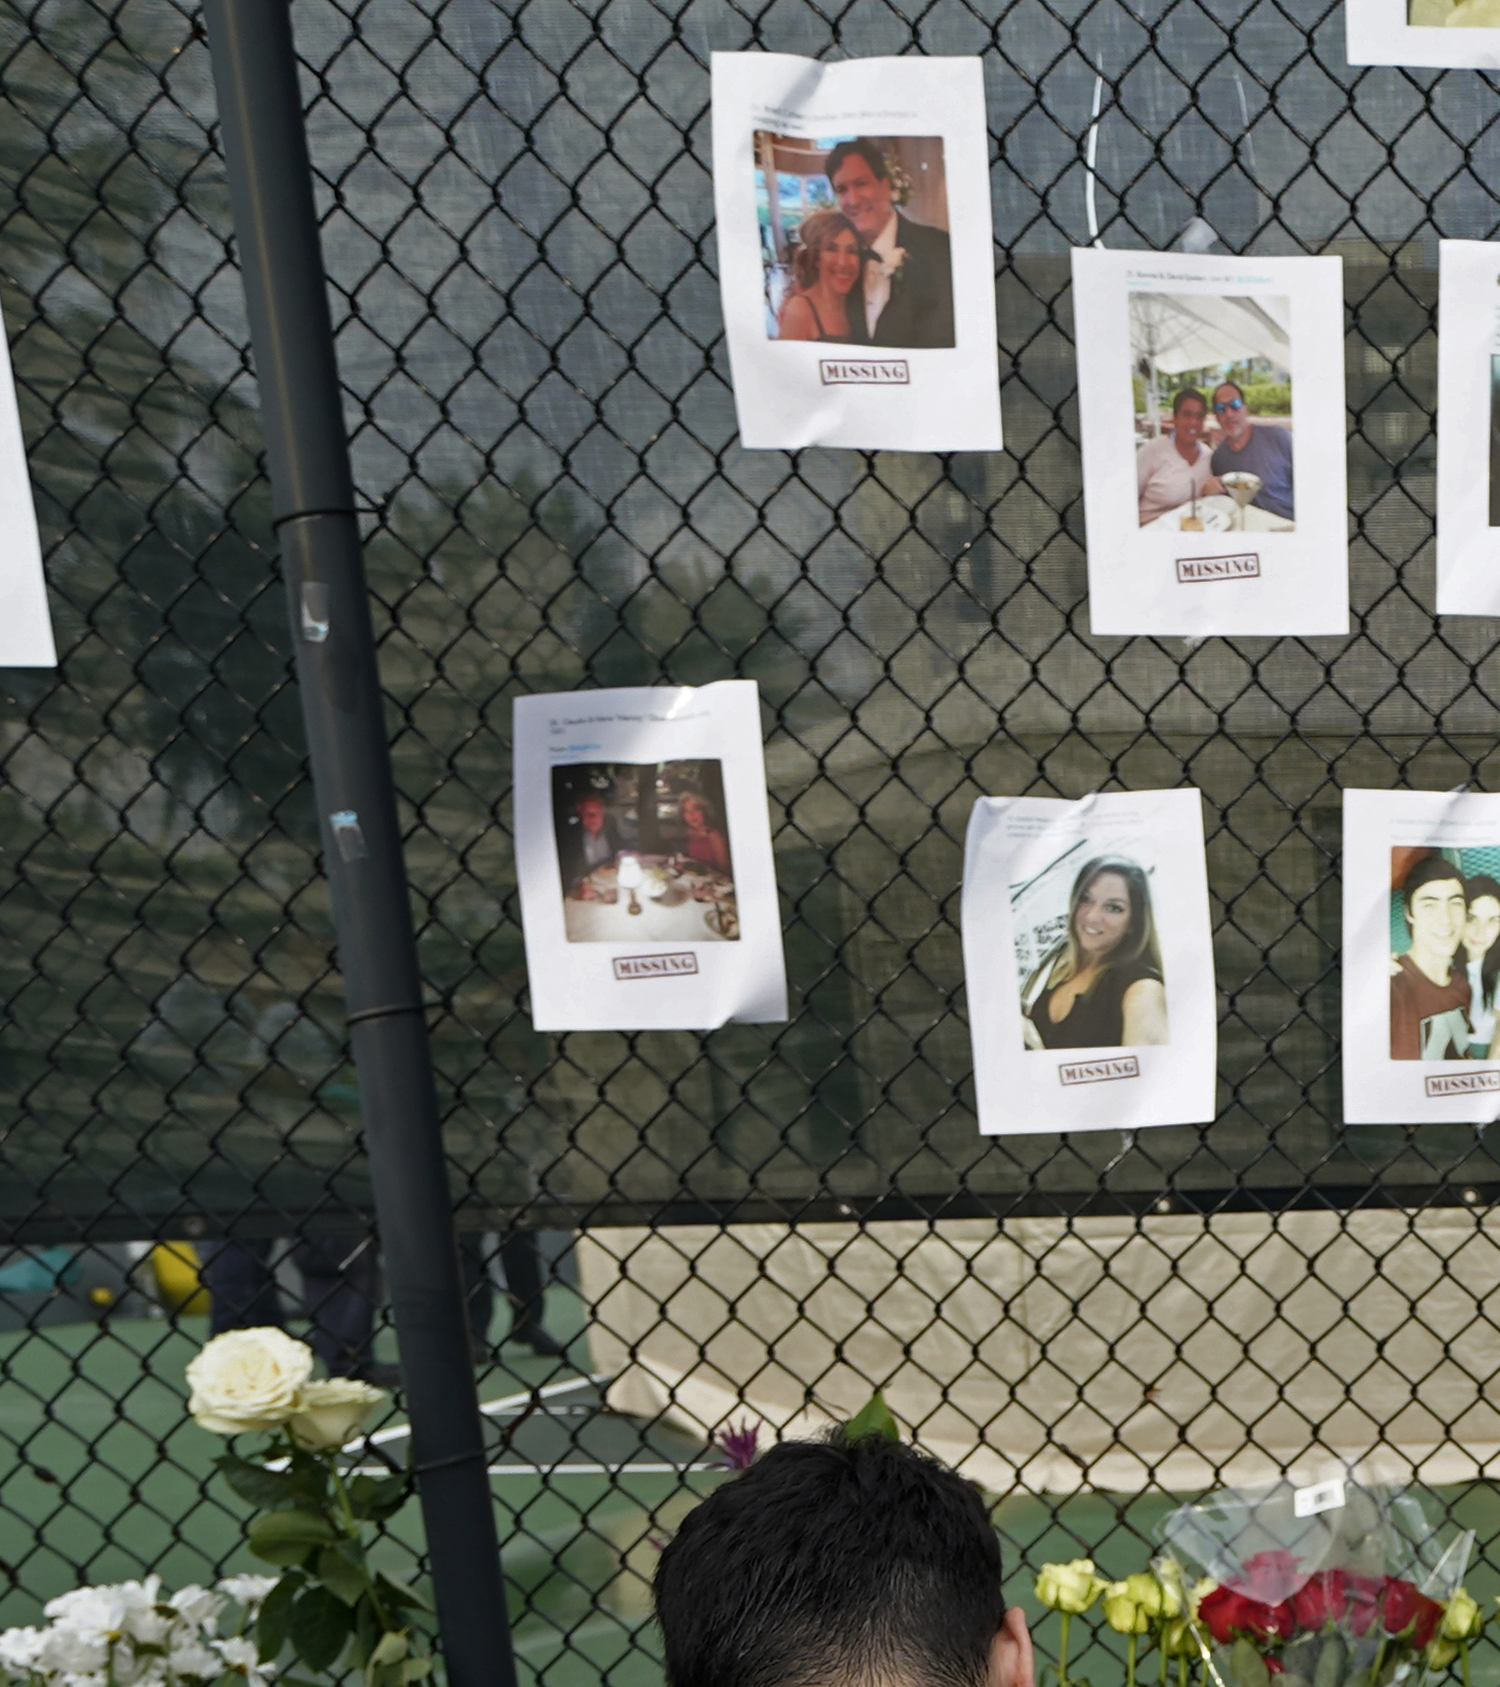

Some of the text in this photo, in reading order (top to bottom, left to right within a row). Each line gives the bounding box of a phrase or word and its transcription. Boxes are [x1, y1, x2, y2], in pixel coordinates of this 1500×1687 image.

[824, 362, 905, 380] MISSING
[1180, 557, 1256, 579] MISSING
[618, 956, 694, 976] MISSING
[1063, 1059, 1136, 1082] MISSING
[1429, 1073, 1499, 1093] MISSING
